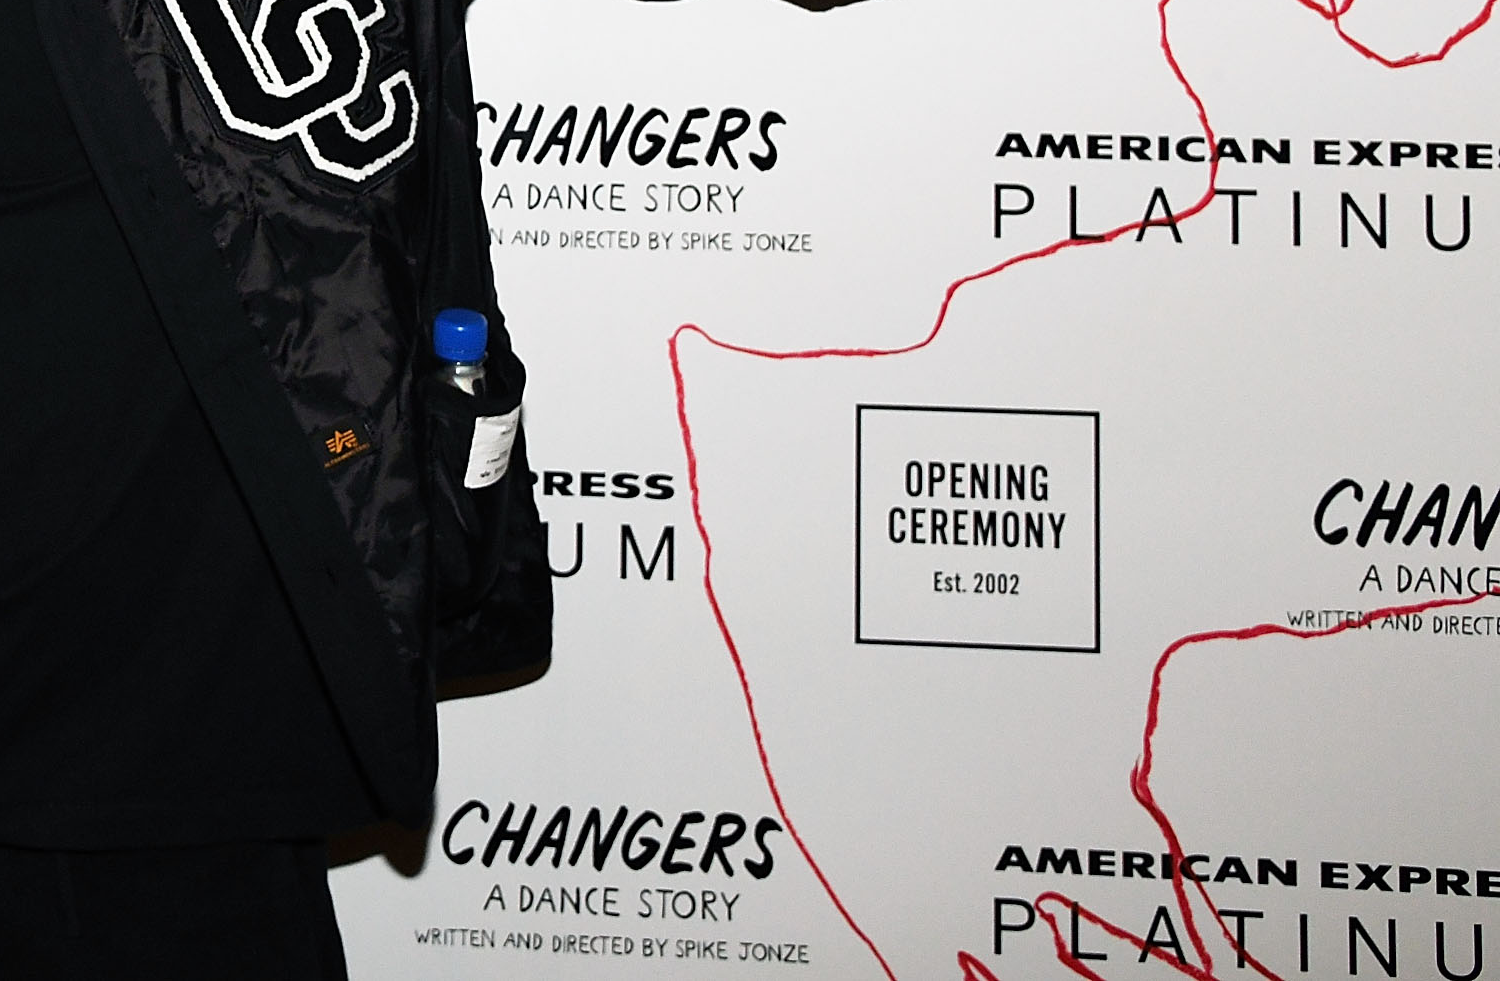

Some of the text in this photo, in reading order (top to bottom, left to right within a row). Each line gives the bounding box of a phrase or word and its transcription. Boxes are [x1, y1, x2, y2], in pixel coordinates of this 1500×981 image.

[996, 133, 1290, 164] AMERICAN
[492, 184, 743, 213] A DANCE STORY
[993, 182, 1471, 252] PLATINU
[511, 230, 550, 247] AND
[560, 230, 640, 250] DIRECTED
[648, 232, 673, 250] BY
[681, 232, 732, 251] SPIKE
[743, 233, 812, 253] JONZE
[529, 470, 675, 500] RESS
[906, 461, 1048, 501] OPENING
[889, 507, 1065, 549] CEREMONY
[934, 571, 1020, 596] Est. 2002
[1359, 564, 1500, 597] A DANCE
[1287, 610, 1372, 630] WRITTEN
[1381, 613, 1423, 632] AND
[442, 799, 784, 879] CHANGERS
[994, 845, 1298, 886] AMERICAN
[484, 885, 739, 921] A DANCE STORY
[414, 928, 810, 964] WRITTEN AND DIRECTED BY SPIKE JONZE
[993, 897, 1484, 981] PLATINU
